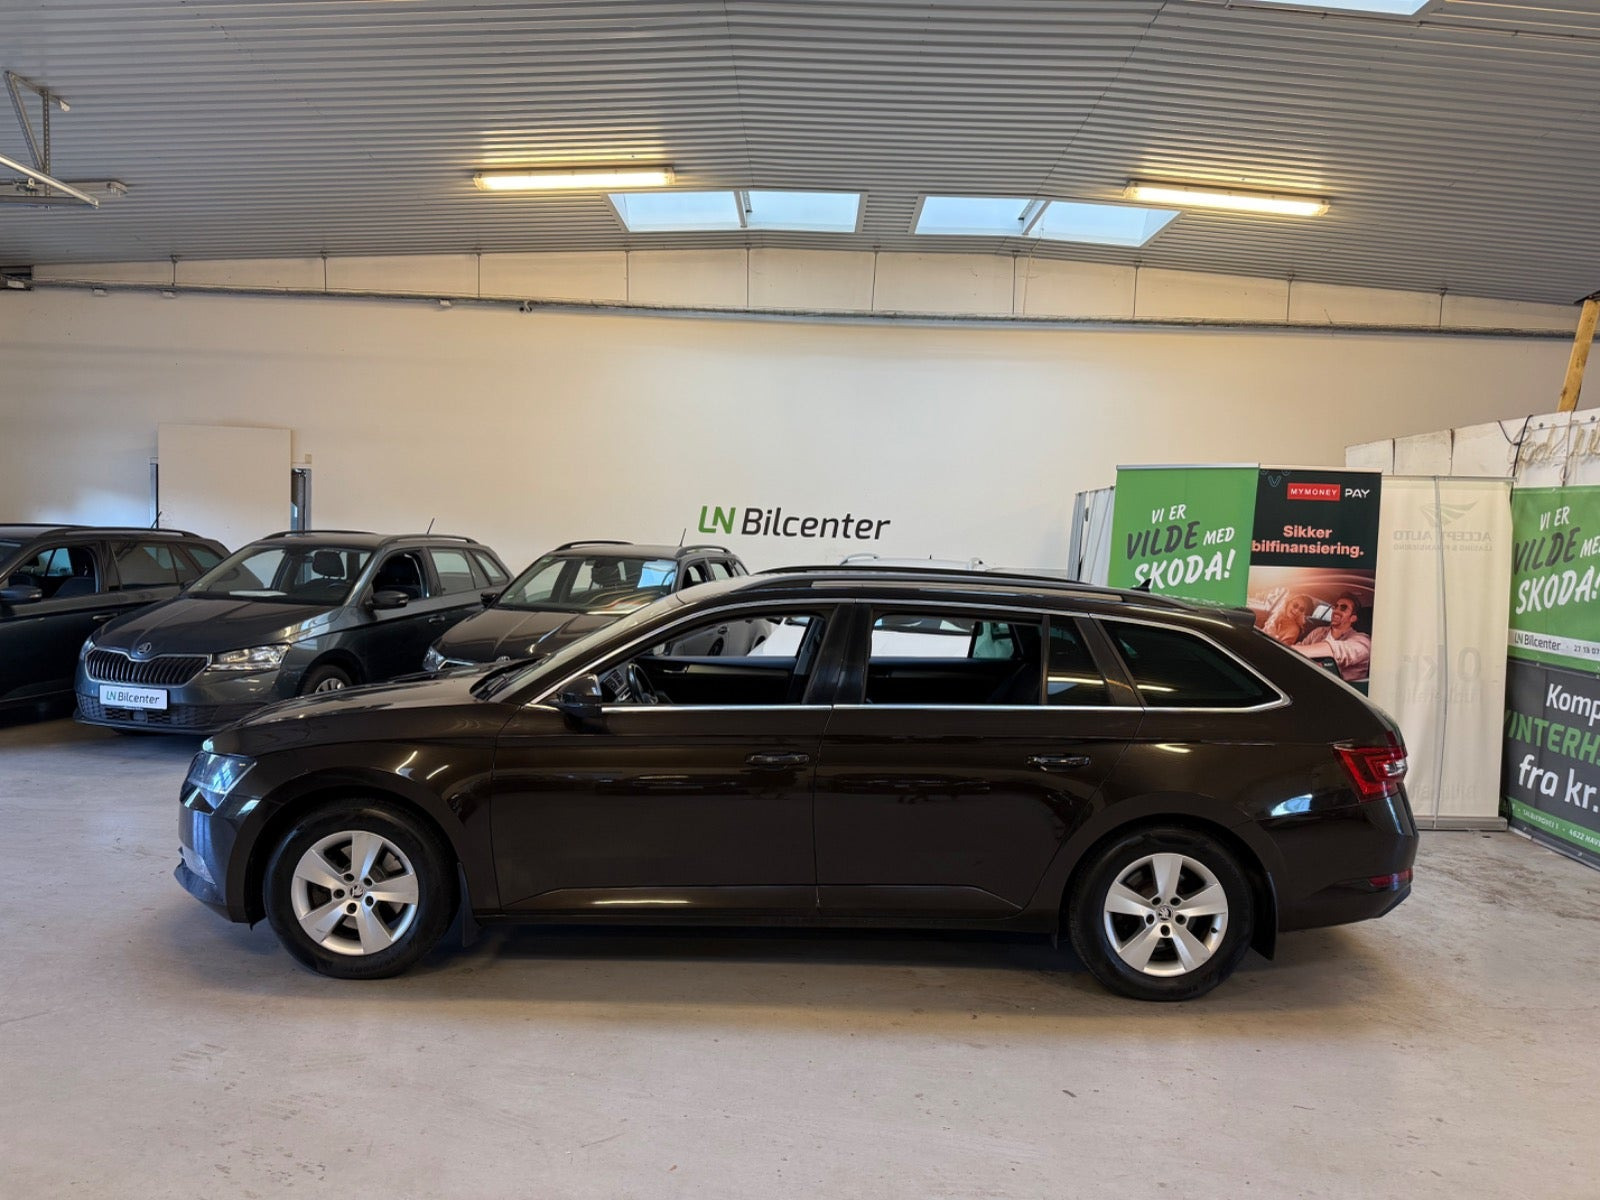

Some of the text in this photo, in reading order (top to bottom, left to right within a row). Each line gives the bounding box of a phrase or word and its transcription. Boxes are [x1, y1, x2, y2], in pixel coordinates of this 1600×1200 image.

[1290, 488, 1370, 498] MYMONEY PAY
[698, 505, 891, 540] LN Bilcenter
[1152, 504, 1187, 524] VI ER
[1540, 506, 1570, 531] VI ER
[1127, 521, 1235, 560] VILDE MED
[1251, 540, 1364, 558] bilfinansiering.
[1283, 525, 1332, 539] Sikker
[1513, 526, 1581, 575] VILDE
[1132, 549, 1236, 589] SKODA!
[1515, 565, 1600, 614] SKODA!
[1524, 634, 1561, 651] Bilcenter
[117, 691, 160, 704] Bilcenter
[1545, 683, 1600, 727] Komp
[1504, 709, 1600, 768] INTERH
[1518, 754, 1559, 797] fra
[1564, 767, 1599, 813] kr.
